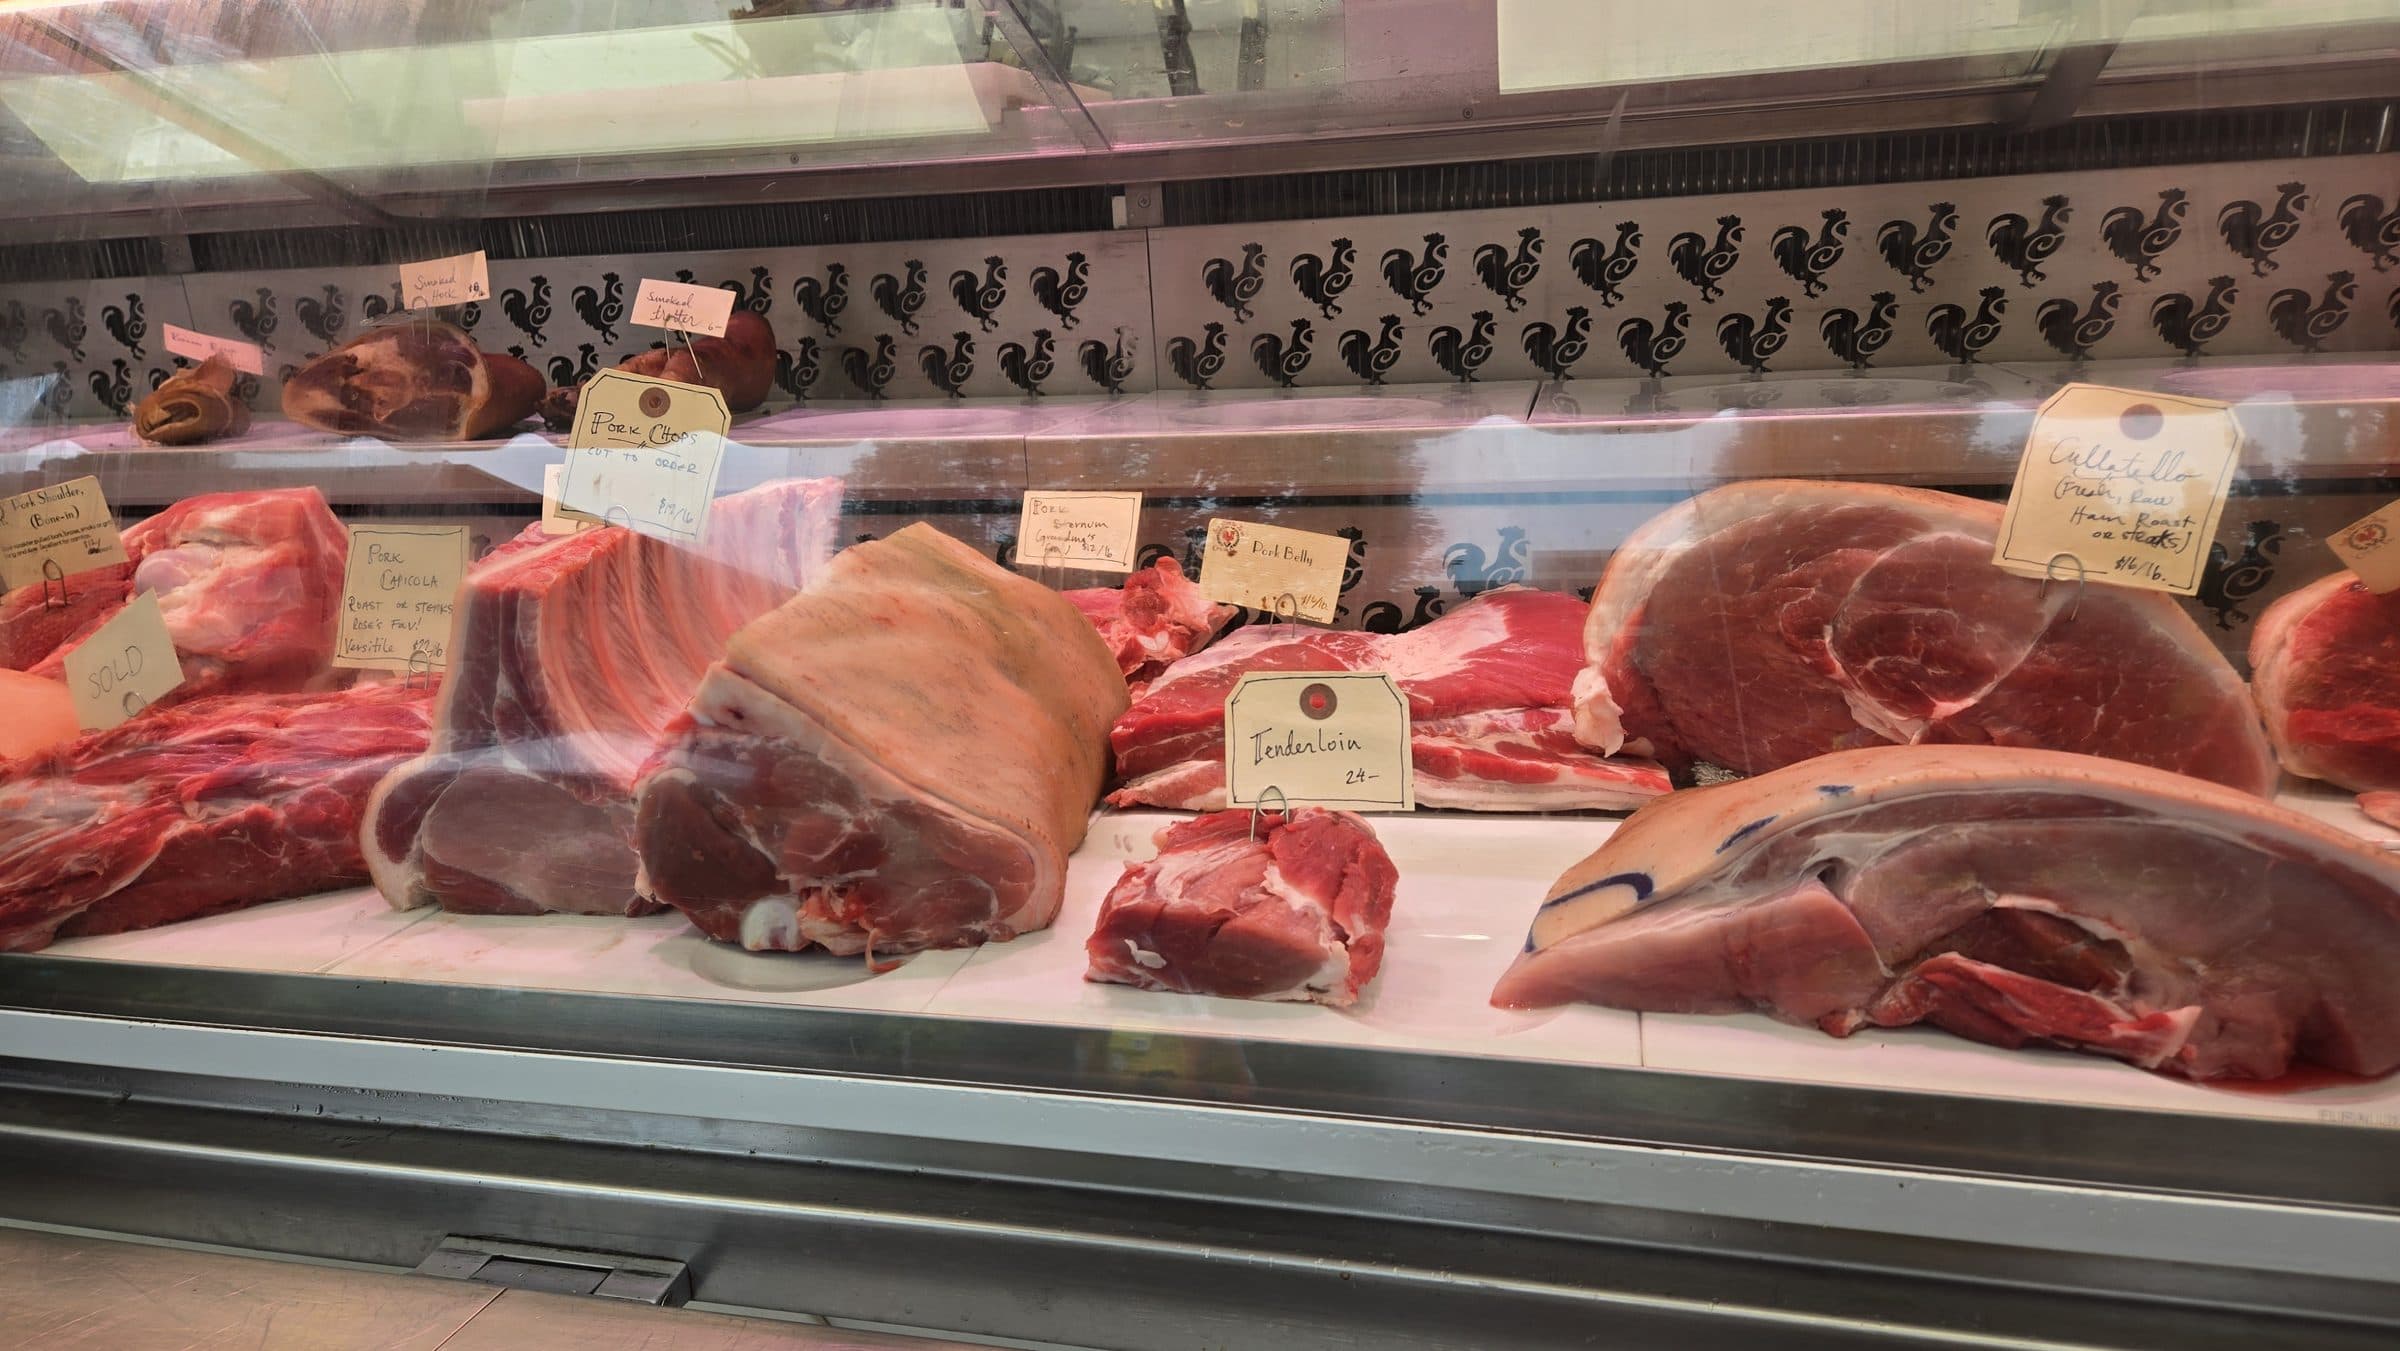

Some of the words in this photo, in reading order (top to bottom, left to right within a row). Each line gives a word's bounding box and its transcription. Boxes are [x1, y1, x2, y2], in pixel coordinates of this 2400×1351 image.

[414, 264, 456, 290] Smoked
[646, 291, 695, 308] Smoked
[591, 411, 641, 434] PORK
[587, 446, 614, 459] CUT
[623, 452, 638, 462] TO
[37, 483, 84, 505] Shoulder,
[30, 504, 80, 530] (Bone-in)
[2069, 505, 2127, 526] Ham
[2137, 511, 2197, 529] Roast
[368, 543, 405, 565] PORK
[1252, 540, 1280, 559] Pork
[1283, 545, 1313, 568] Belly
[380, 568, 439, 591] CAPICOLA
[88, 644, 144, 700] SOLD
[1249, 727, 1362, 766] Tenderloin
